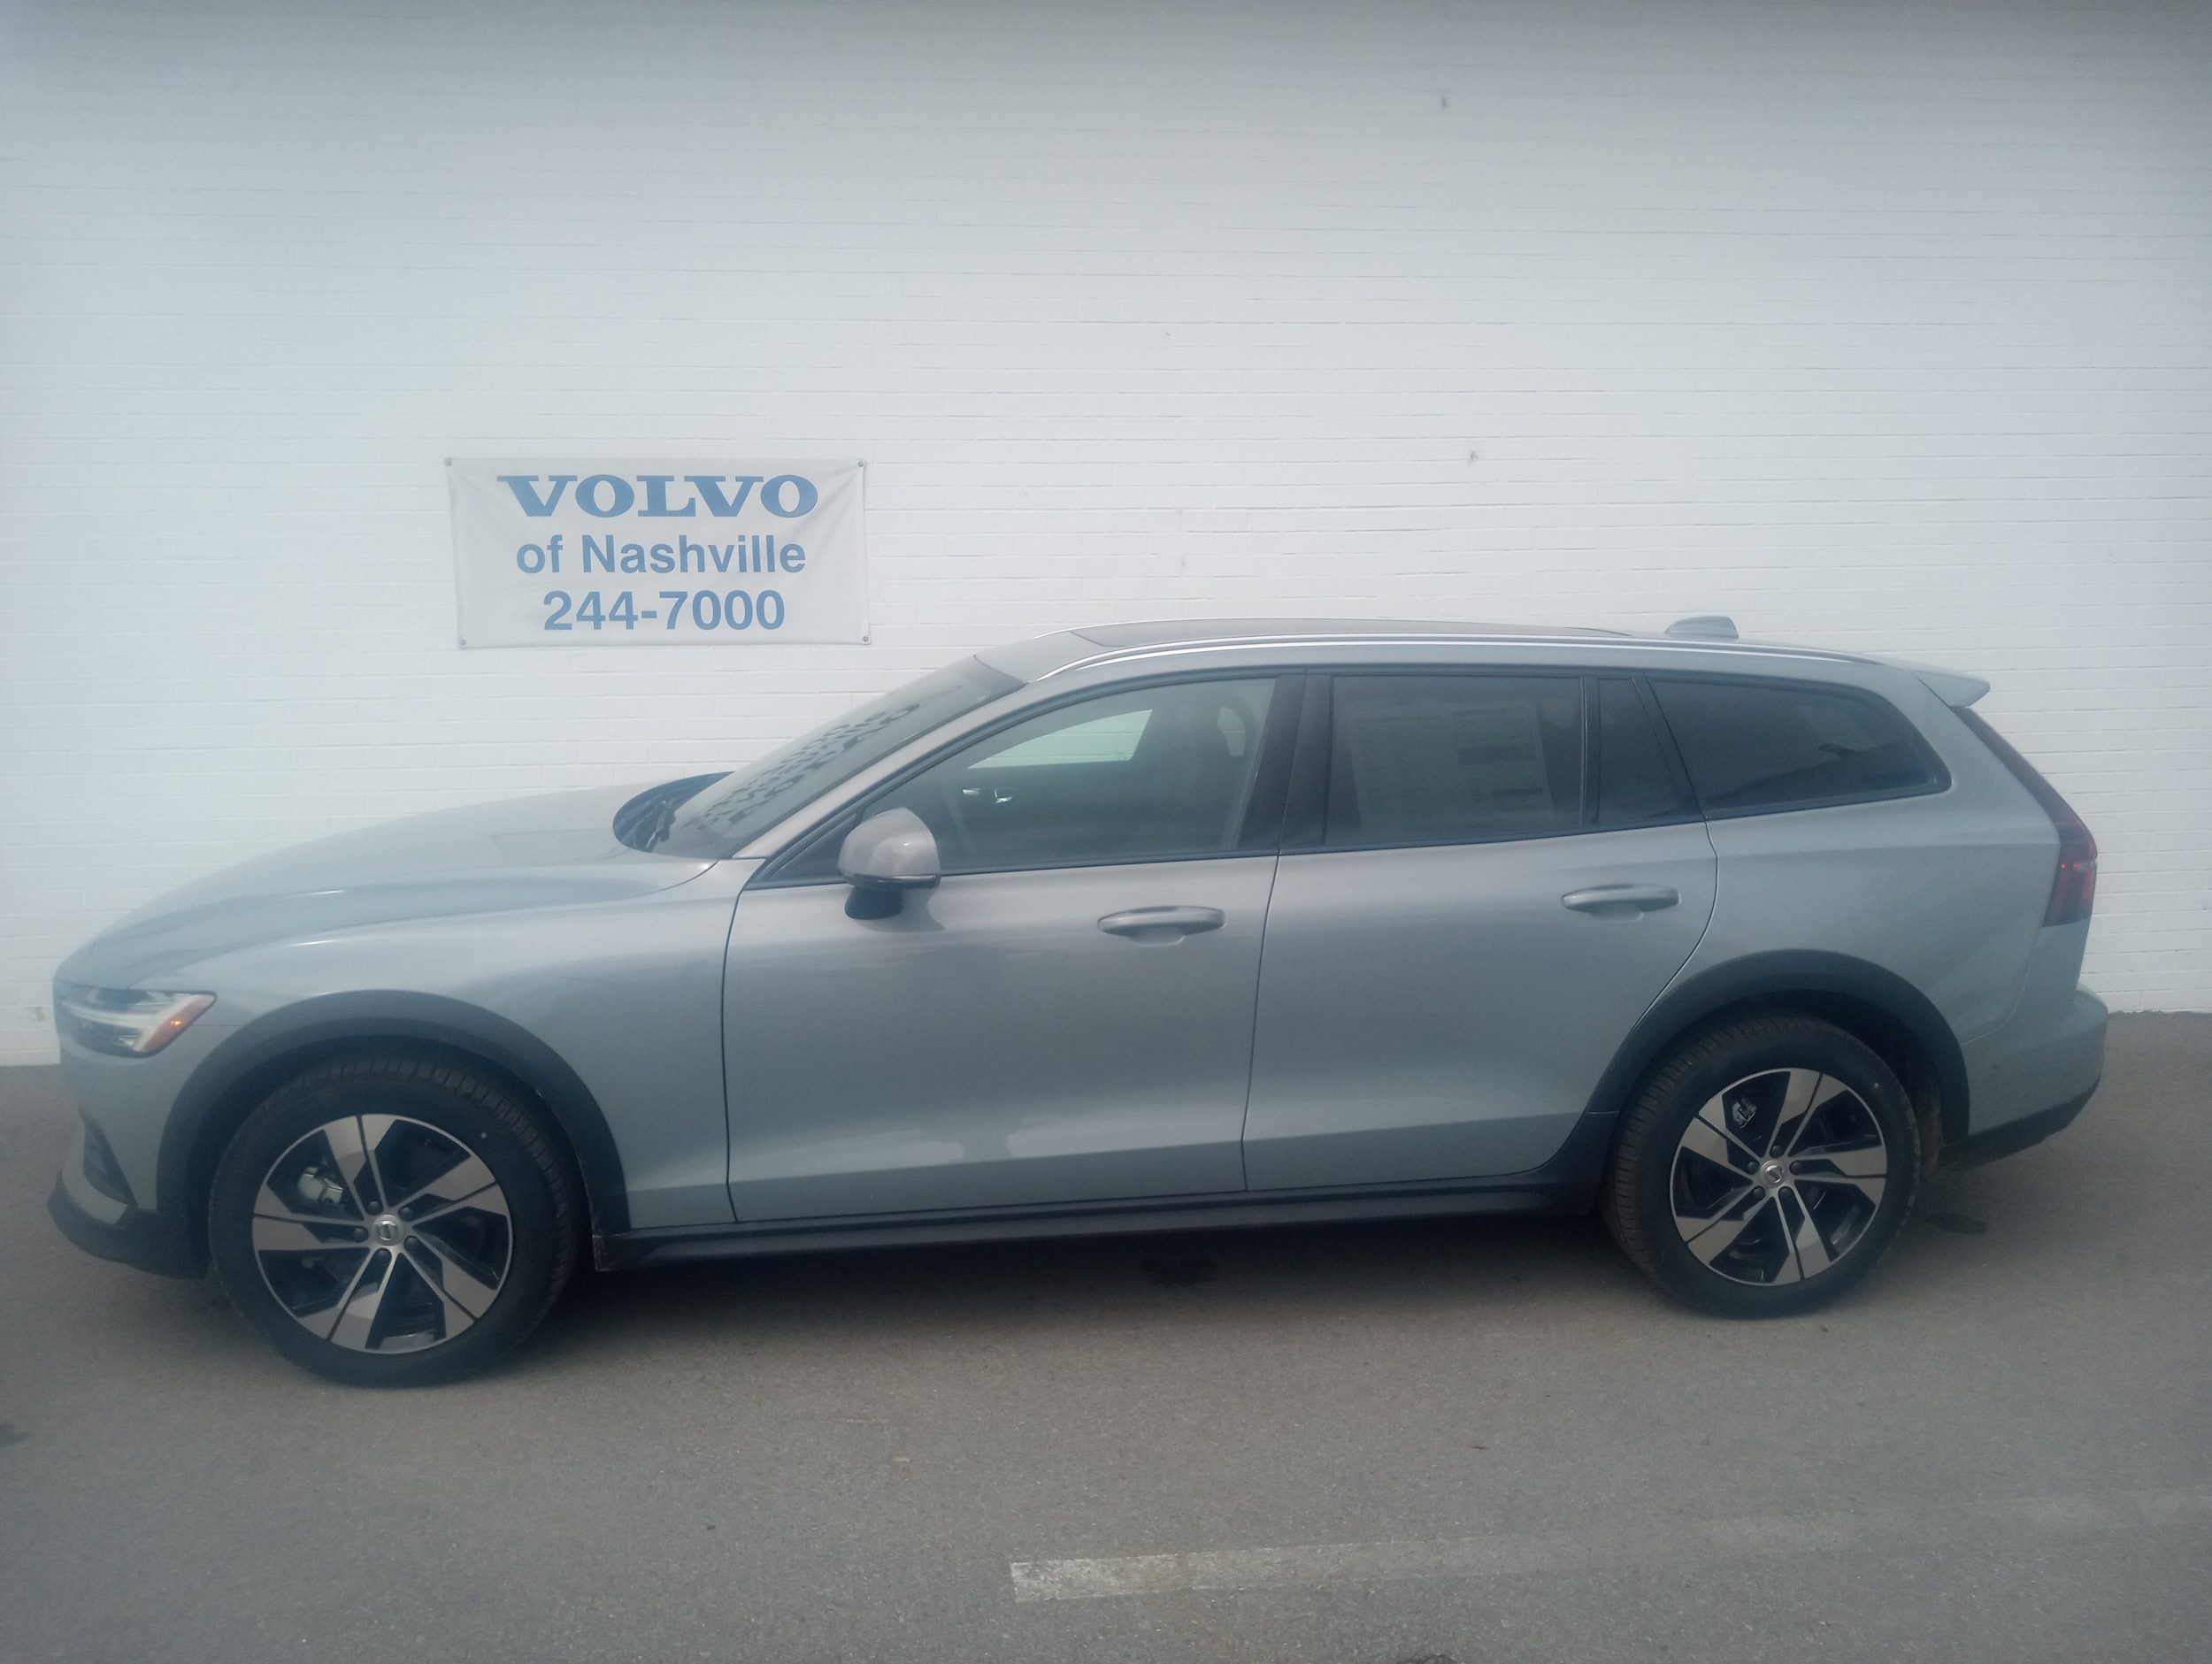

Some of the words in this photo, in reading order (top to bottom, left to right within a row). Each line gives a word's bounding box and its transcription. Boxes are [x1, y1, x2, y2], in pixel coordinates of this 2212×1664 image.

[497, 474, 818, 518] VOLVO
[517, 534, 564, 574] of
[582, 534, 806, 574] Nashville
[543, 589, 786, 631] 244-7000
